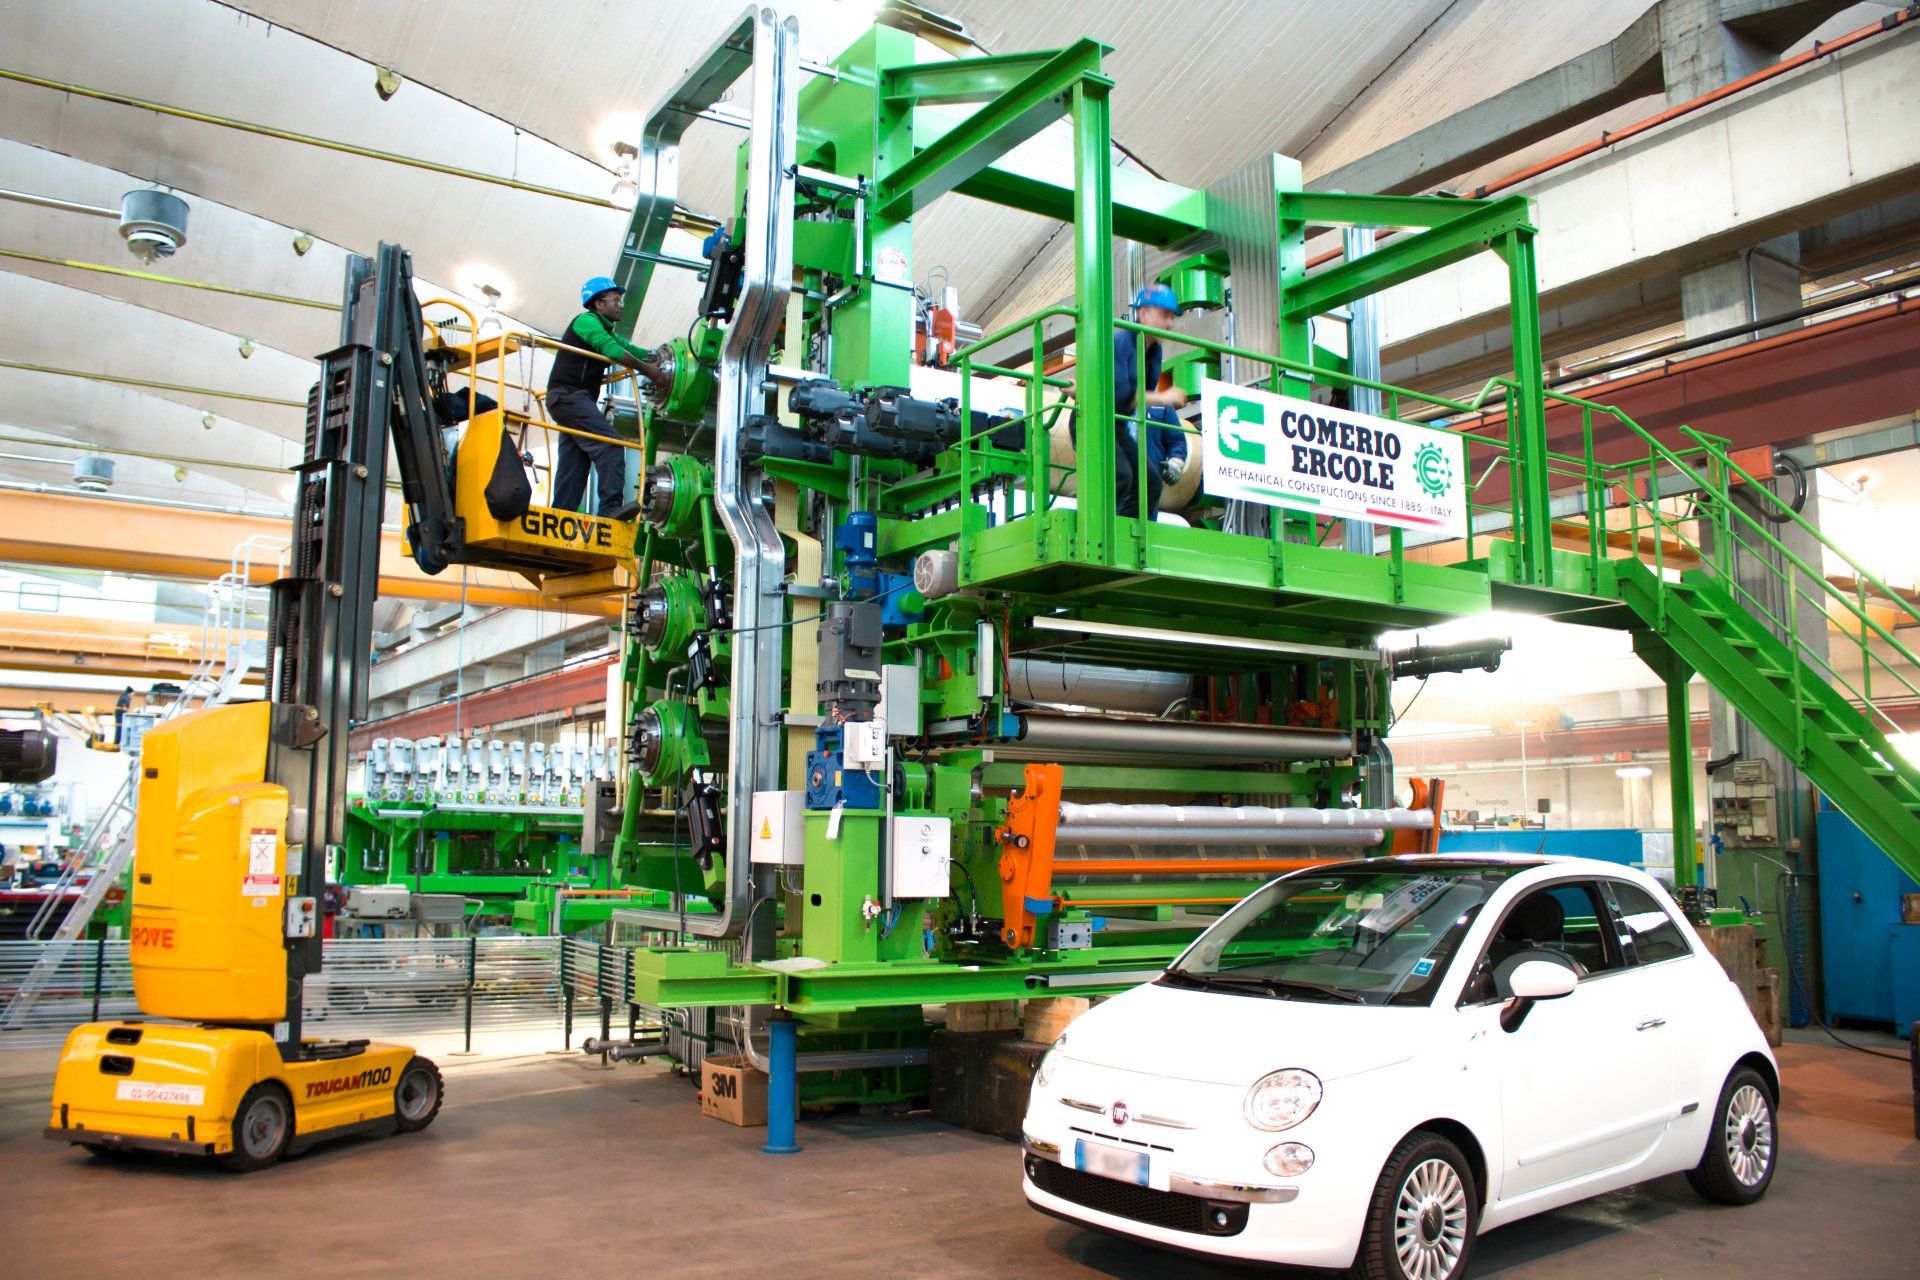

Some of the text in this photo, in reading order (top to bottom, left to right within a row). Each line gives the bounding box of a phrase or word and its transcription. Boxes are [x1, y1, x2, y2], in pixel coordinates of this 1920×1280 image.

[1281, 410, 1401, 460] COMERIO
[1291, 444, 1394, 490] ERCOLE
[1218, 466, 1284, 487] MECHANICAL
[1287, 479, 1367, 503] CONSTRUCTIONS
[1370, 494, 1396, 508] SINCE
[1400, 499, 1422, 513] 1885
[1430, 506, 1452, 518] ITALY
[520, 510, 612, 547] GROVE
[131, 927, 174, 949] ROVE
[711, 1072, 737, 1099] 3M
